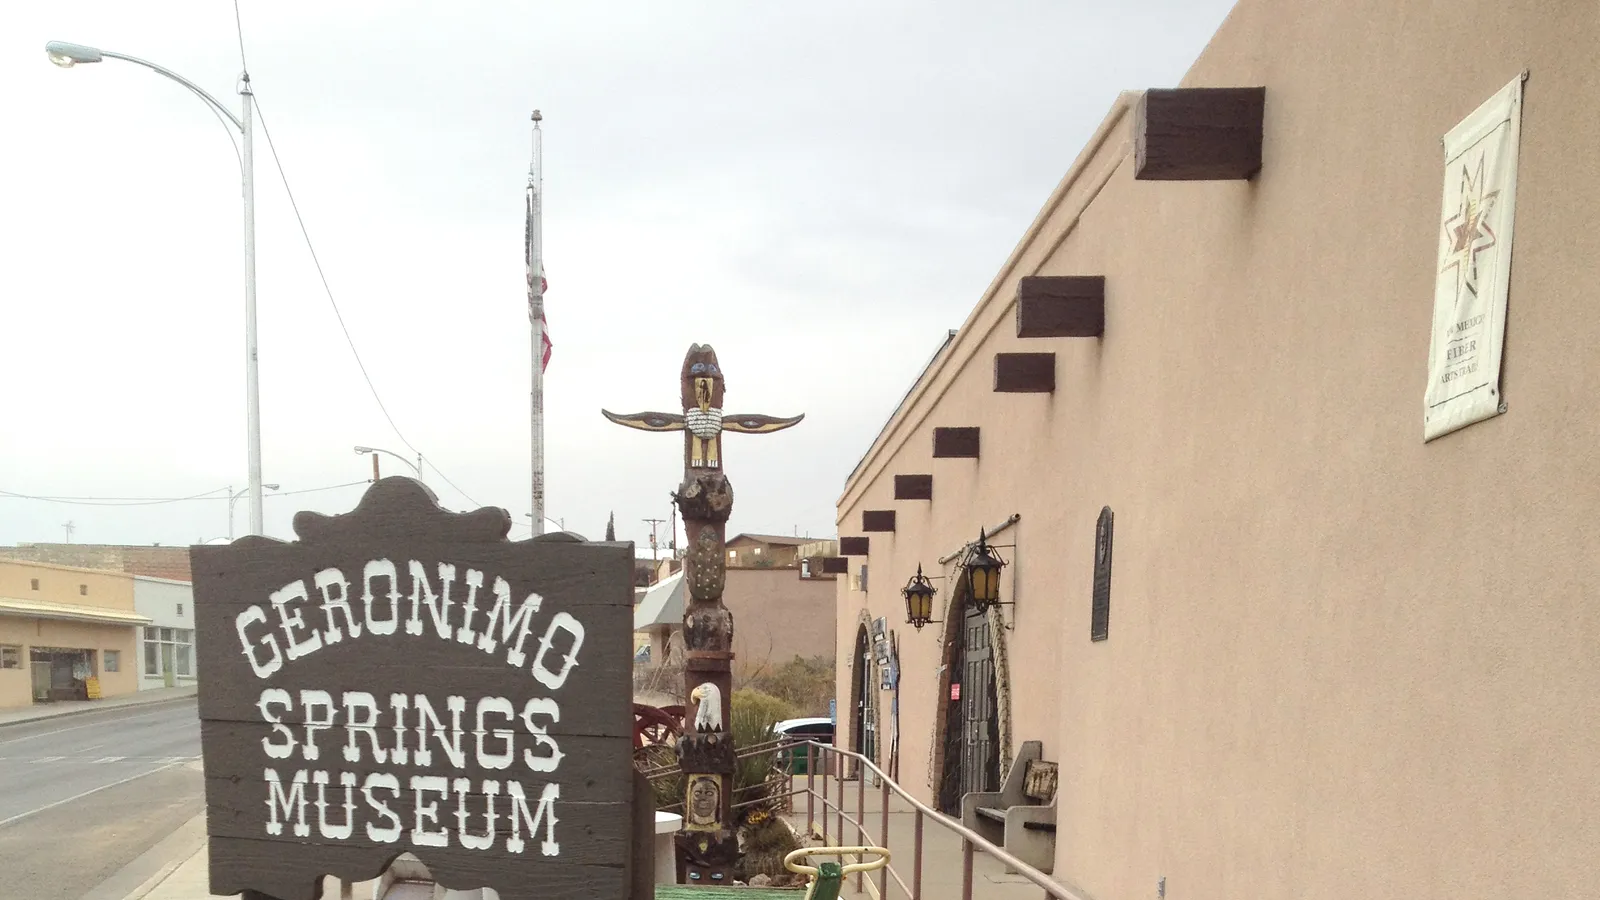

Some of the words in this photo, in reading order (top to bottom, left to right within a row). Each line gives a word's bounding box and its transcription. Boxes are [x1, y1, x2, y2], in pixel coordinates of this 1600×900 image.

[1447, 340, 1476, 360] FIBER
[235, 558, 585, 689] GERONIMO
[255, 689, 565, 772] SPRINGS
[264, 768, 560, 857] MUSEUM
